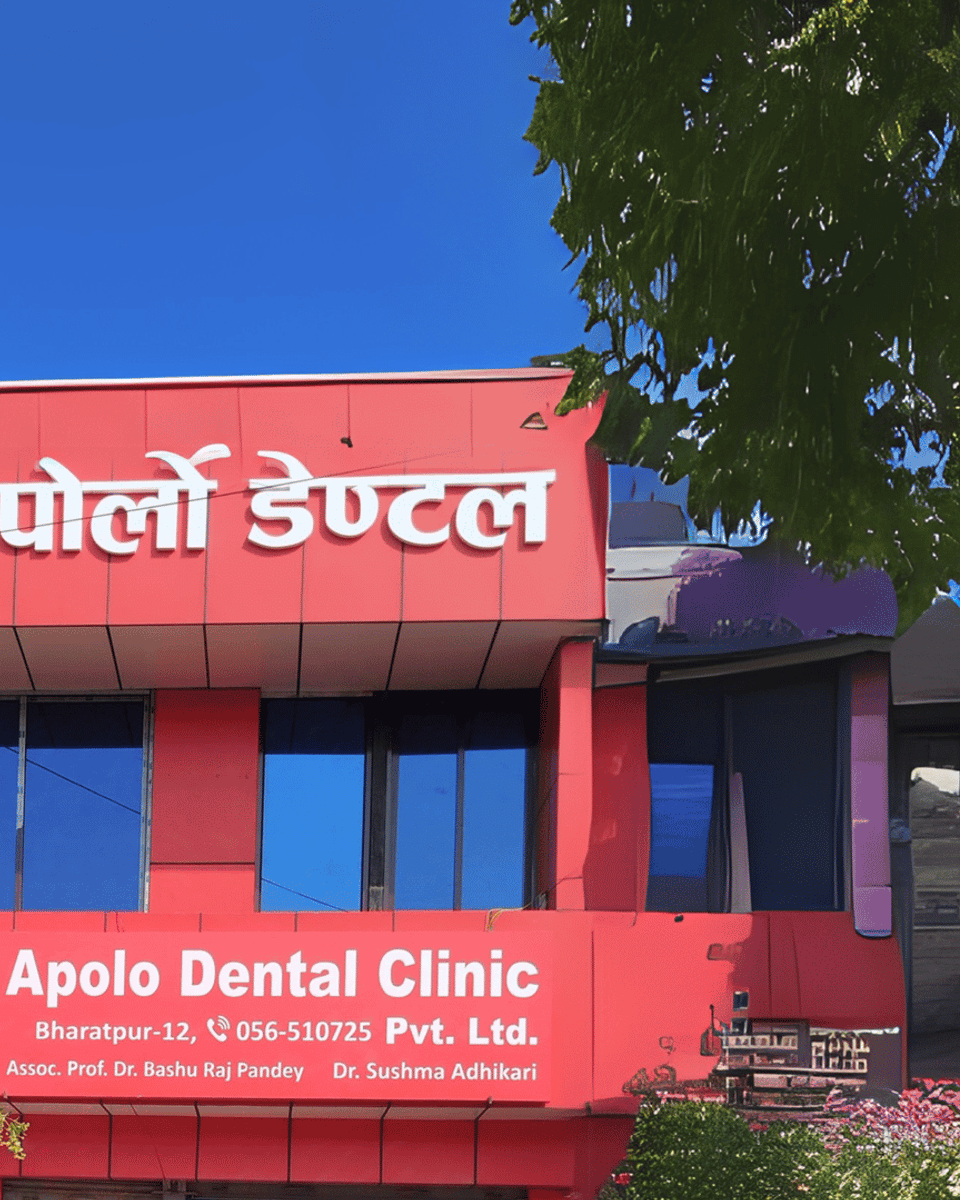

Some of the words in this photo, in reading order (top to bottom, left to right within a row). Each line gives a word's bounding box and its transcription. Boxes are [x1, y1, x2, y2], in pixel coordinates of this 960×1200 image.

[248, 450, 557, 549] डेण्टल
[5, 948, 160, 1009] Apolo
[180, 949, 358, 998] Dental
[378, 948, 540, 999] Clinic
[35, 1020, 198, 1046] Bharatpur-12,
[236, 1020, 372, 1043] 056-510725
[385, 1016, 455, 1046] Pvt.
[468, 1017, 538, 1046] Ltd.
[6, 1059, 62, 1077] Assoc.
[67, 1059, 108, 1078] Prof.
[113, 1060, 138, 1078] Dr.
[143, 1060, 198, 1079] Bashu
[203, 1061, 232, 1082] Raj
[237, 1062, 305, 1082] Pandey
[333, 1062, 360, 1080] Dr.
[366, 1061, 445, 1081] Sushma
[450, 1062, 537, 1081] Adhikari
